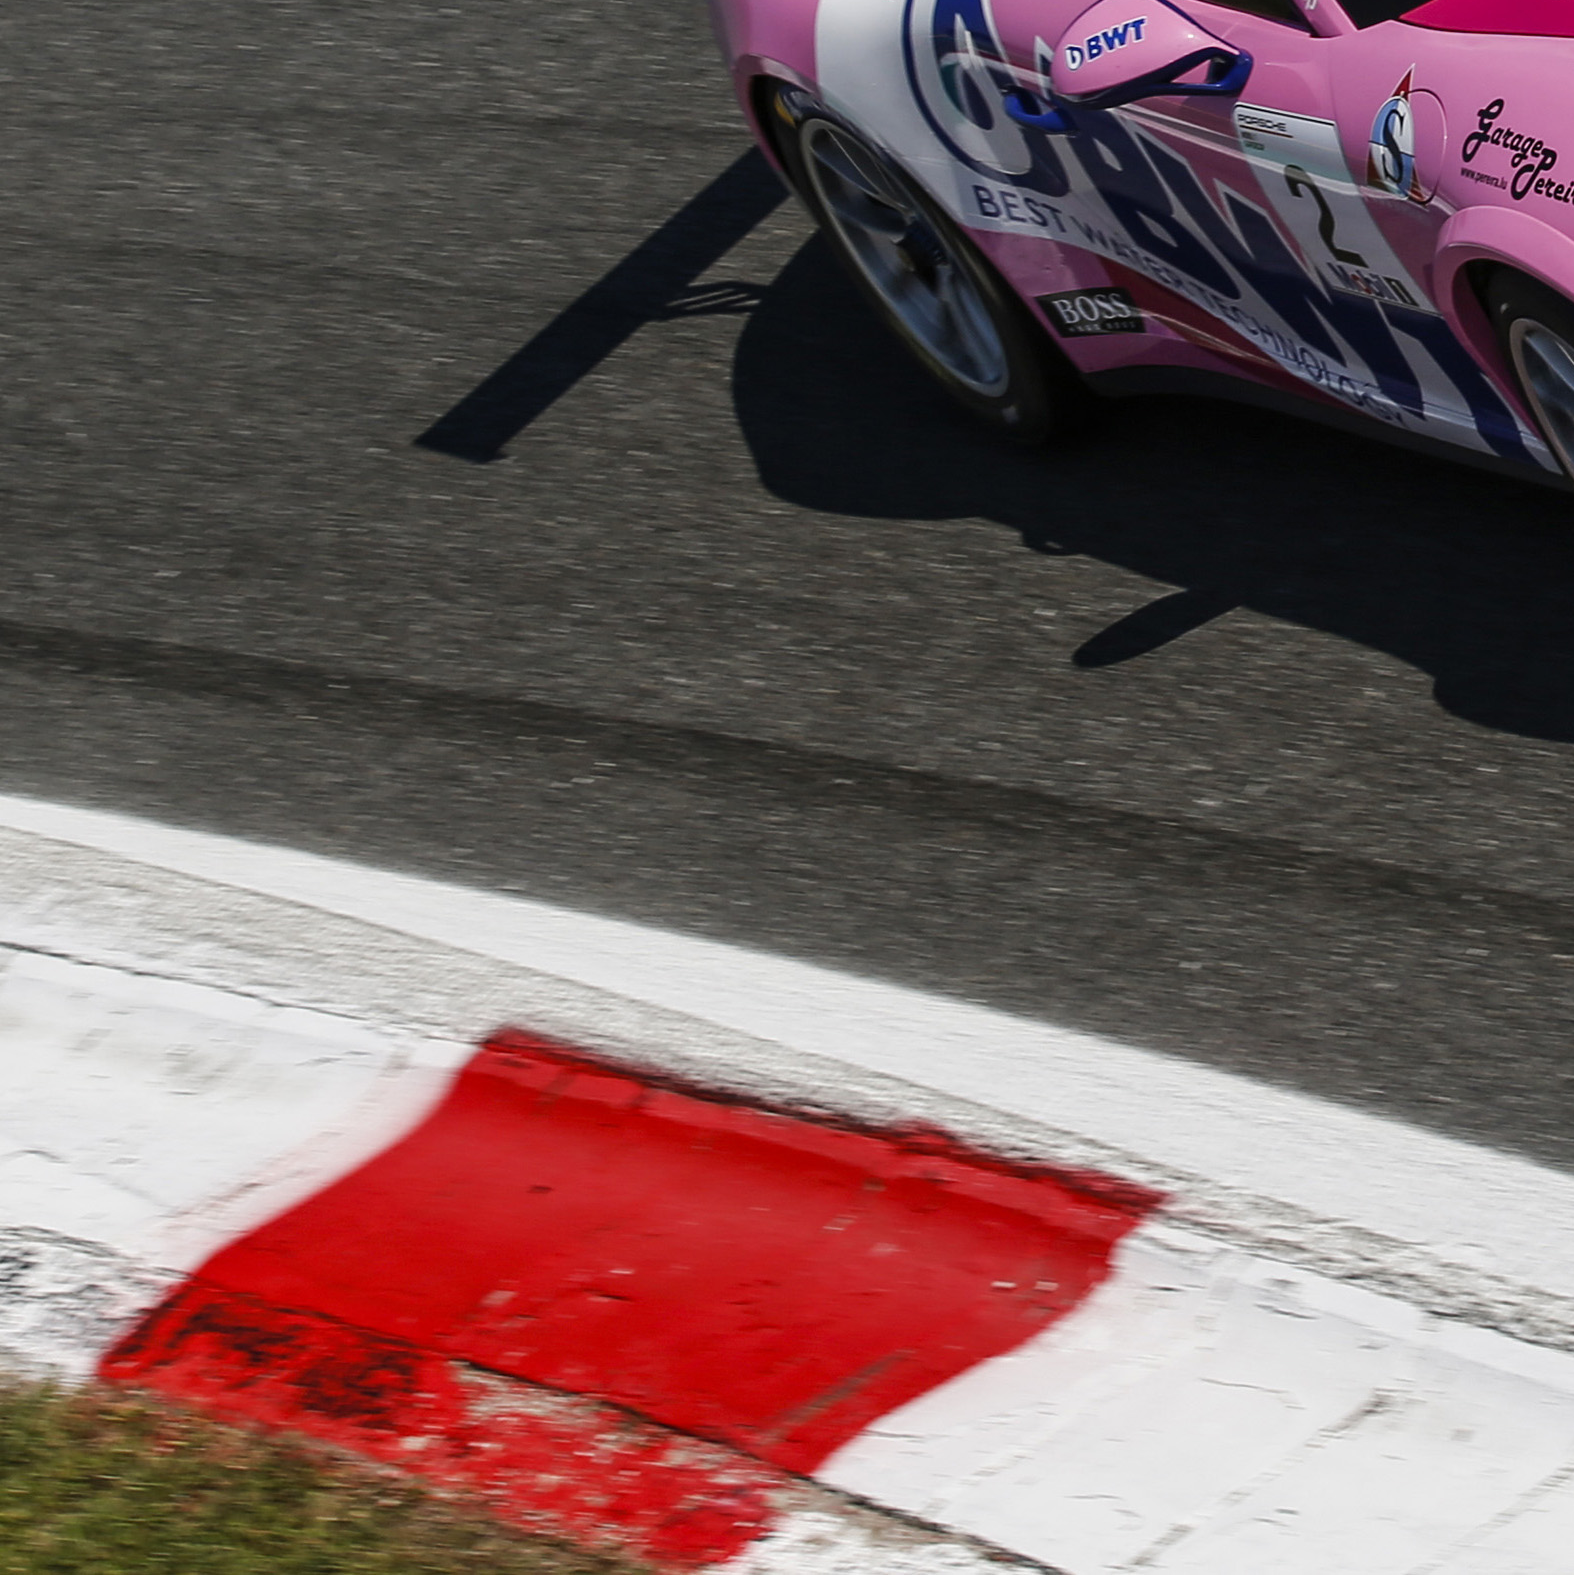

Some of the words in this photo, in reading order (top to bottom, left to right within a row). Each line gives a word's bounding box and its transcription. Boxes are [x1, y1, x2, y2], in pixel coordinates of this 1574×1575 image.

[1085, 16, 1148, 62] BWT
[1462, 98, 1544, 168] Garage
[1460, 167, 1508, 190] www.pereira.lu
[972, 185, 1068, 234] BEST
[1070, 215, 1196, 297] WATER
[1284, 164, 1370, 268] 2
[1052, 293, 1133, 325] BOSS
